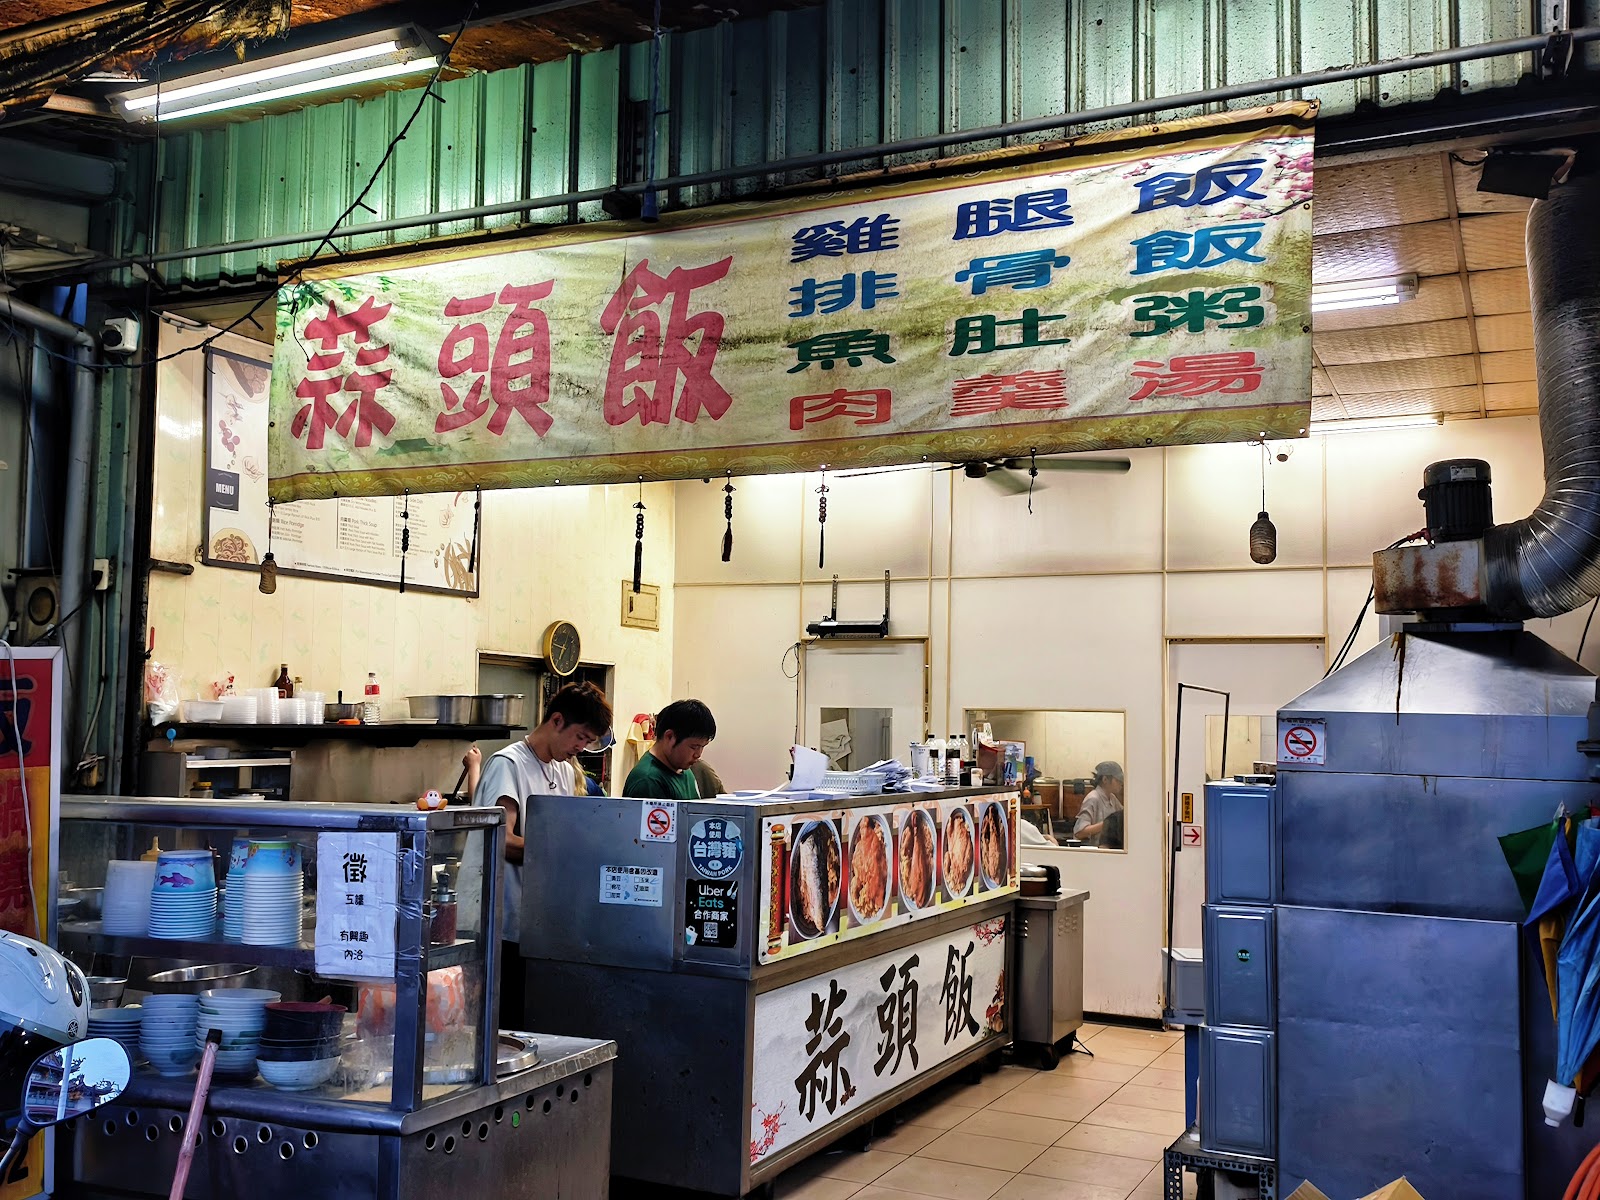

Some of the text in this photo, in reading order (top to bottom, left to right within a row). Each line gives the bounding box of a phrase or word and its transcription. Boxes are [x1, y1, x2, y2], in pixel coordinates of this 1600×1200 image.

[790, 159, 1267, 263] 雞腿飯
[789, 222, 1266, 318] 排骨飯
[787, 287, 1265, 374] 魚肚粥
[291, 255, 734, 449] 蒜頭飯
[789, 351, 1264, 430] 肉羹湯
[215, 483, 234, 495] MENU
[693, 841, 736, 858] 台灣豬
[342, 852, 368, 883] 徵
[697, 864, 733, 876] TAIWAN PORK
[698, 884, 724, 897] Uber
[698, 897, 724, 908] Eats
[694, 909, 728, 921] 合作商家
[340, 930, 369, 942] 有興趣
[795, 940, 980, 1123] 蒜頭飯
